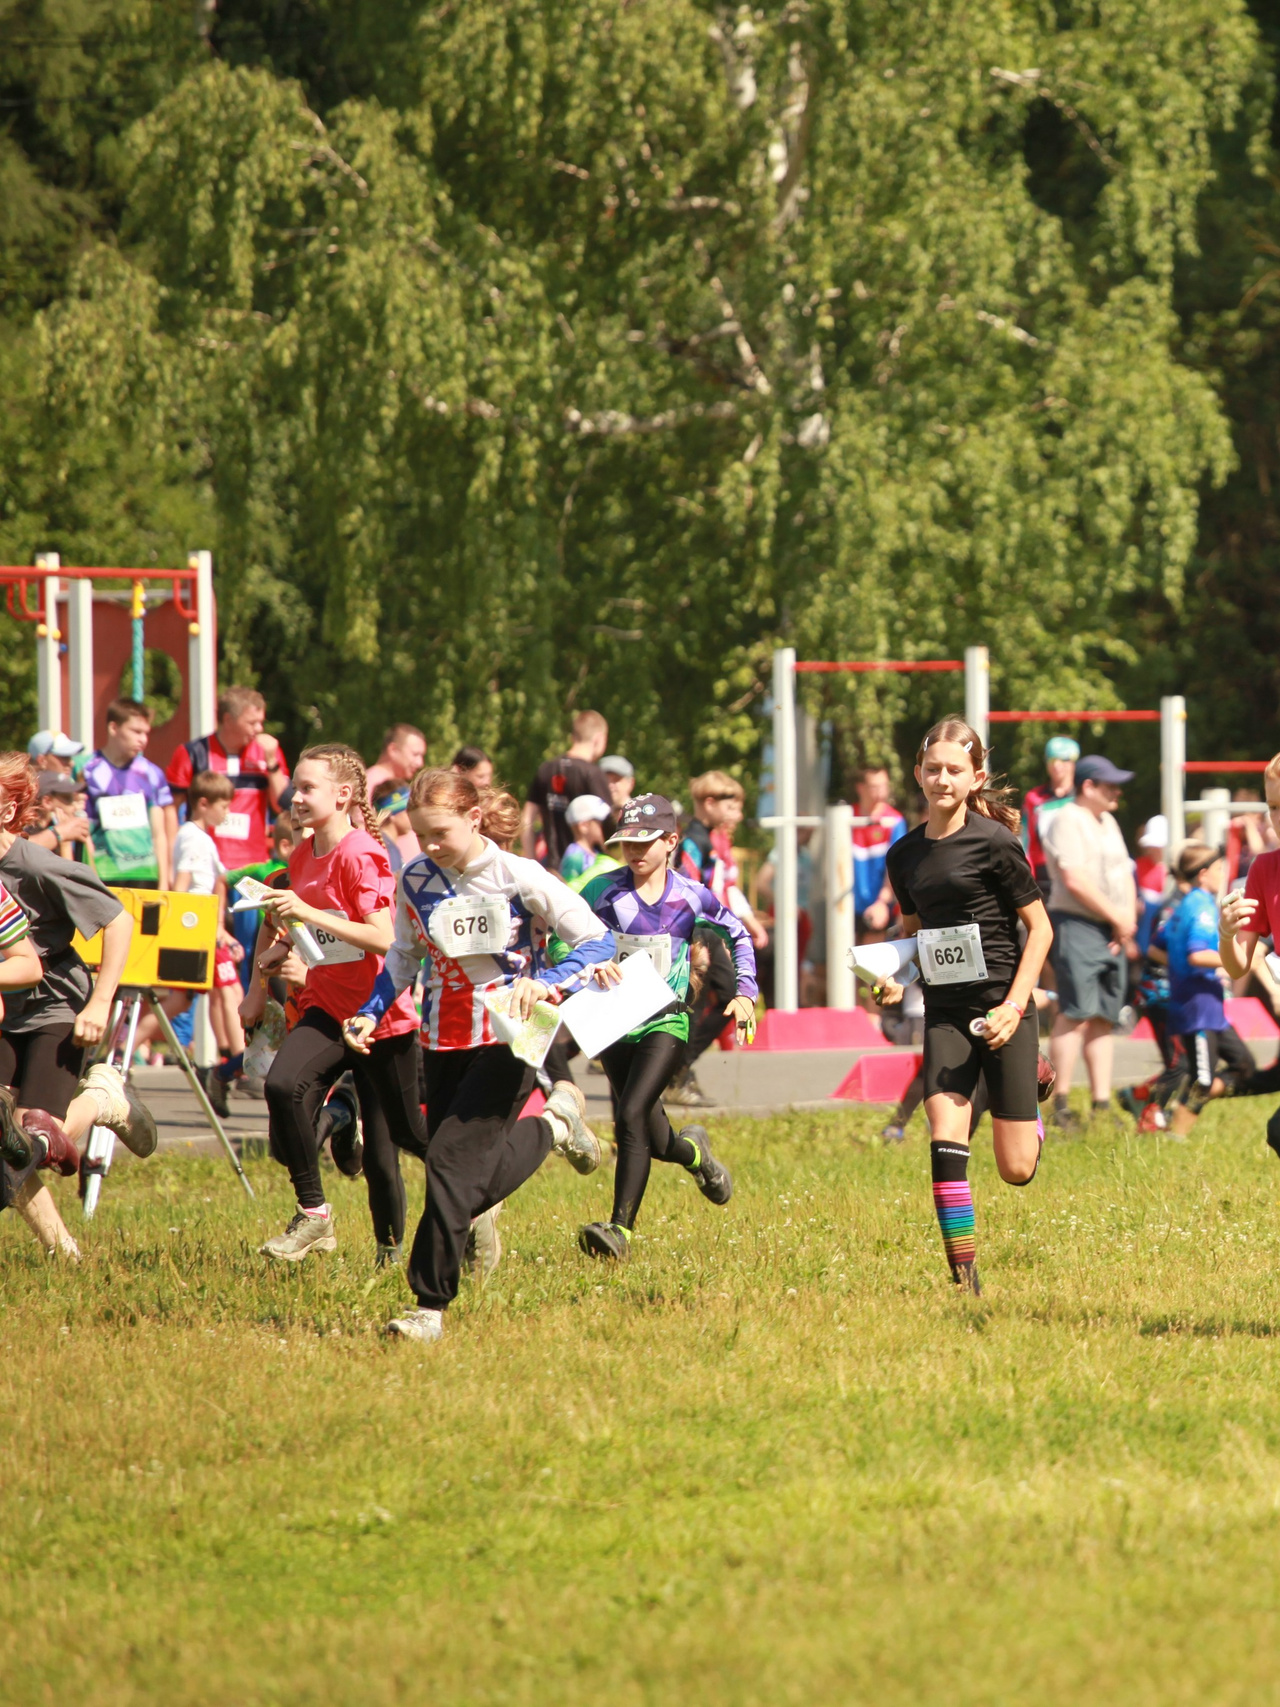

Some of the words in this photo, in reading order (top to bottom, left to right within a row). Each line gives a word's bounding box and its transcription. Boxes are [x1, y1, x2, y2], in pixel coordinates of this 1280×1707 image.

[453, 915, 488, 936] 678
[315, 928, 343, 945] 66
[934, 945, 966, 966] 662
